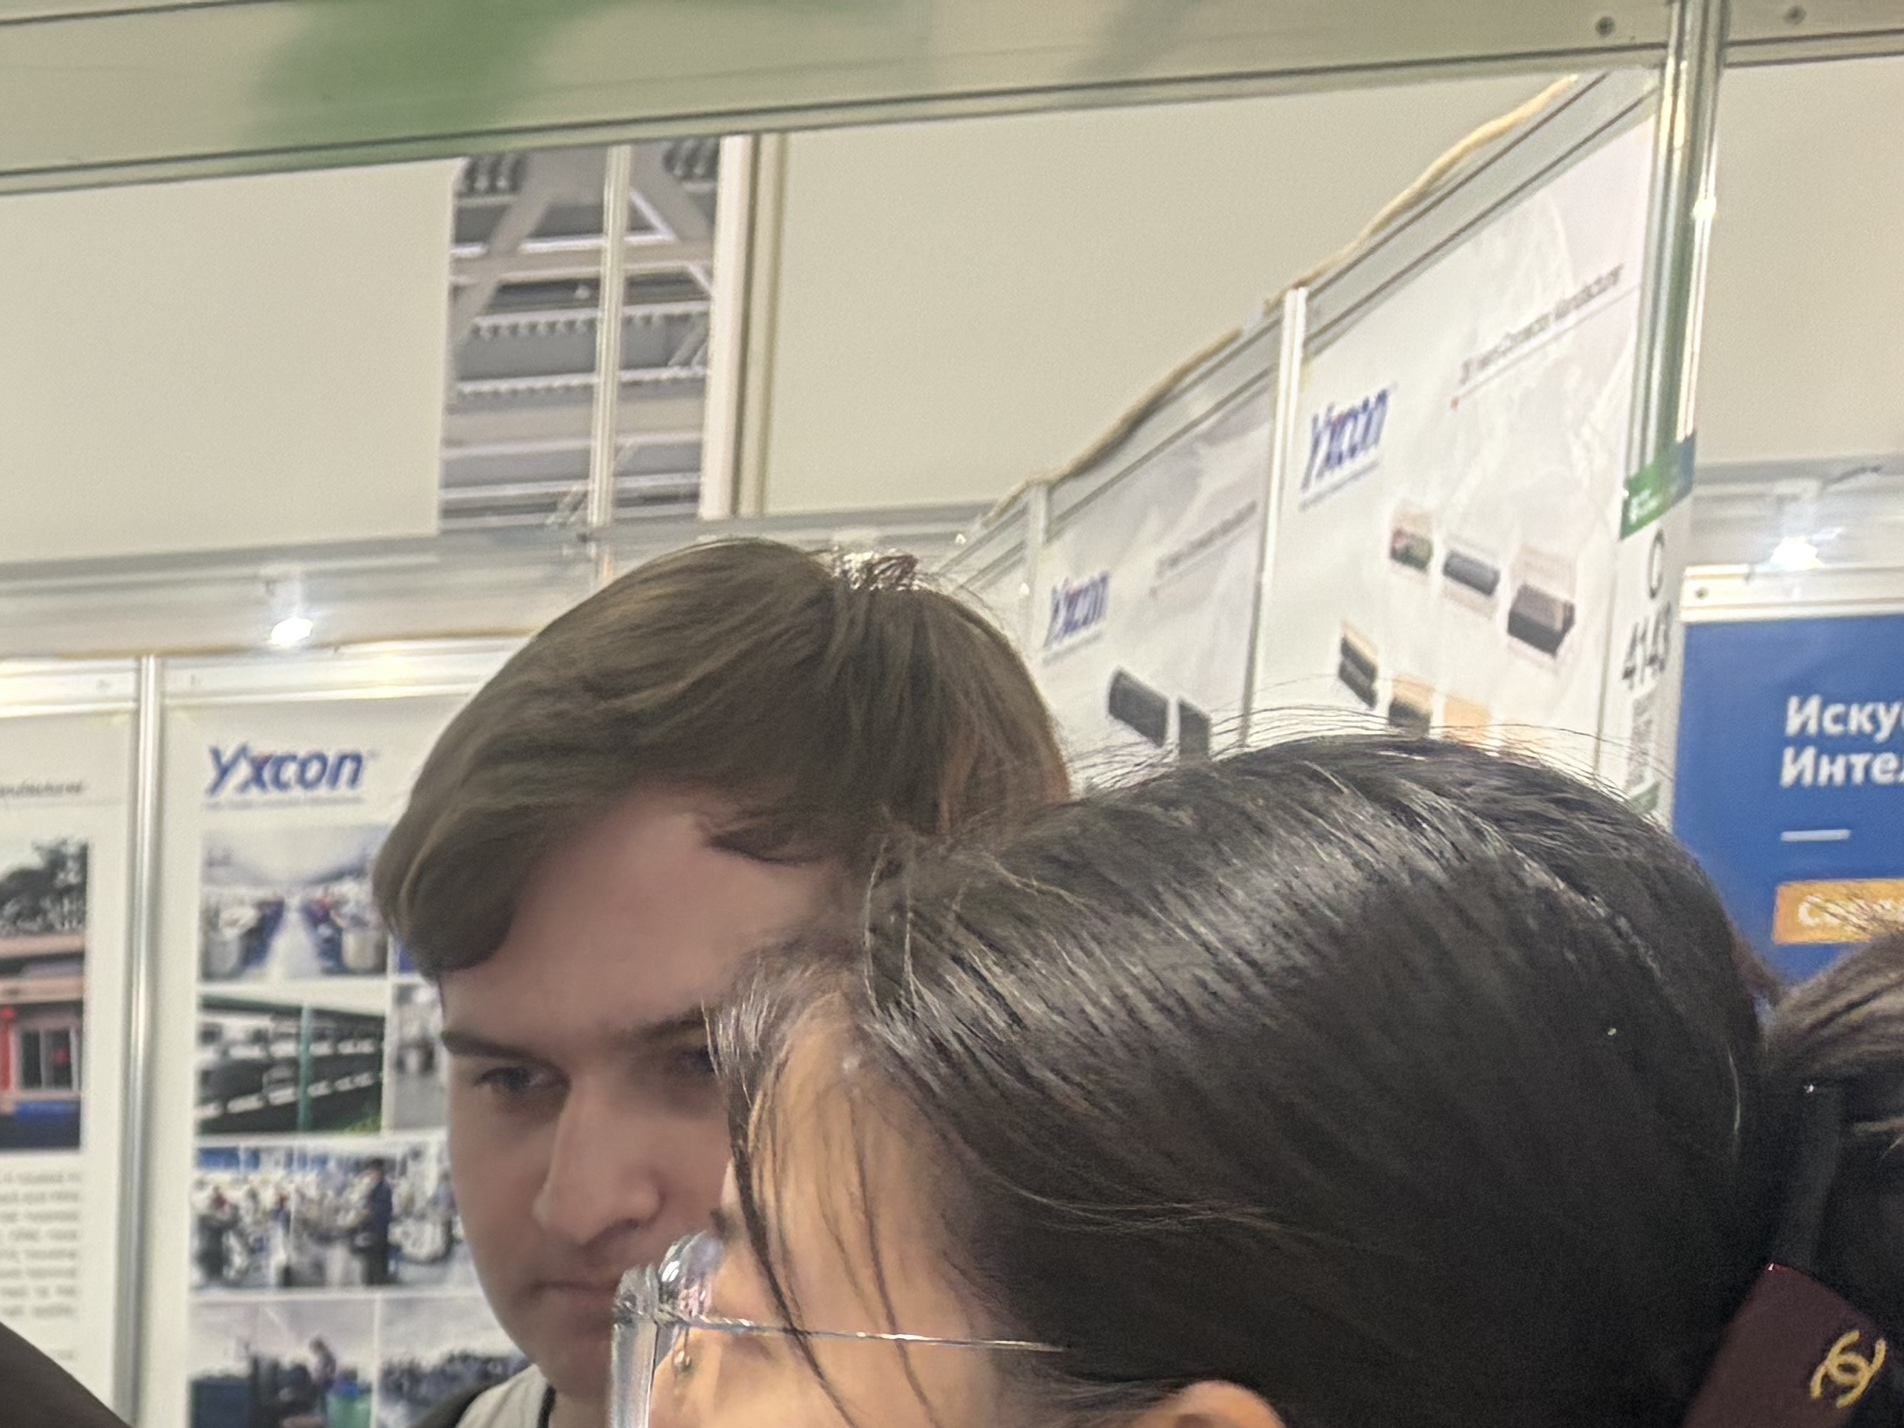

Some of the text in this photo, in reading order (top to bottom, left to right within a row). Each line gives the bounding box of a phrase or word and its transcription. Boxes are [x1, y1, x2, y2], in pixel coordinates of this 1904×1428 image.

[1785, 694, 1904, 743] Иску
[207, 743, 366, 795] Yxcon
[1780, 745, 1904, 788] Инте
